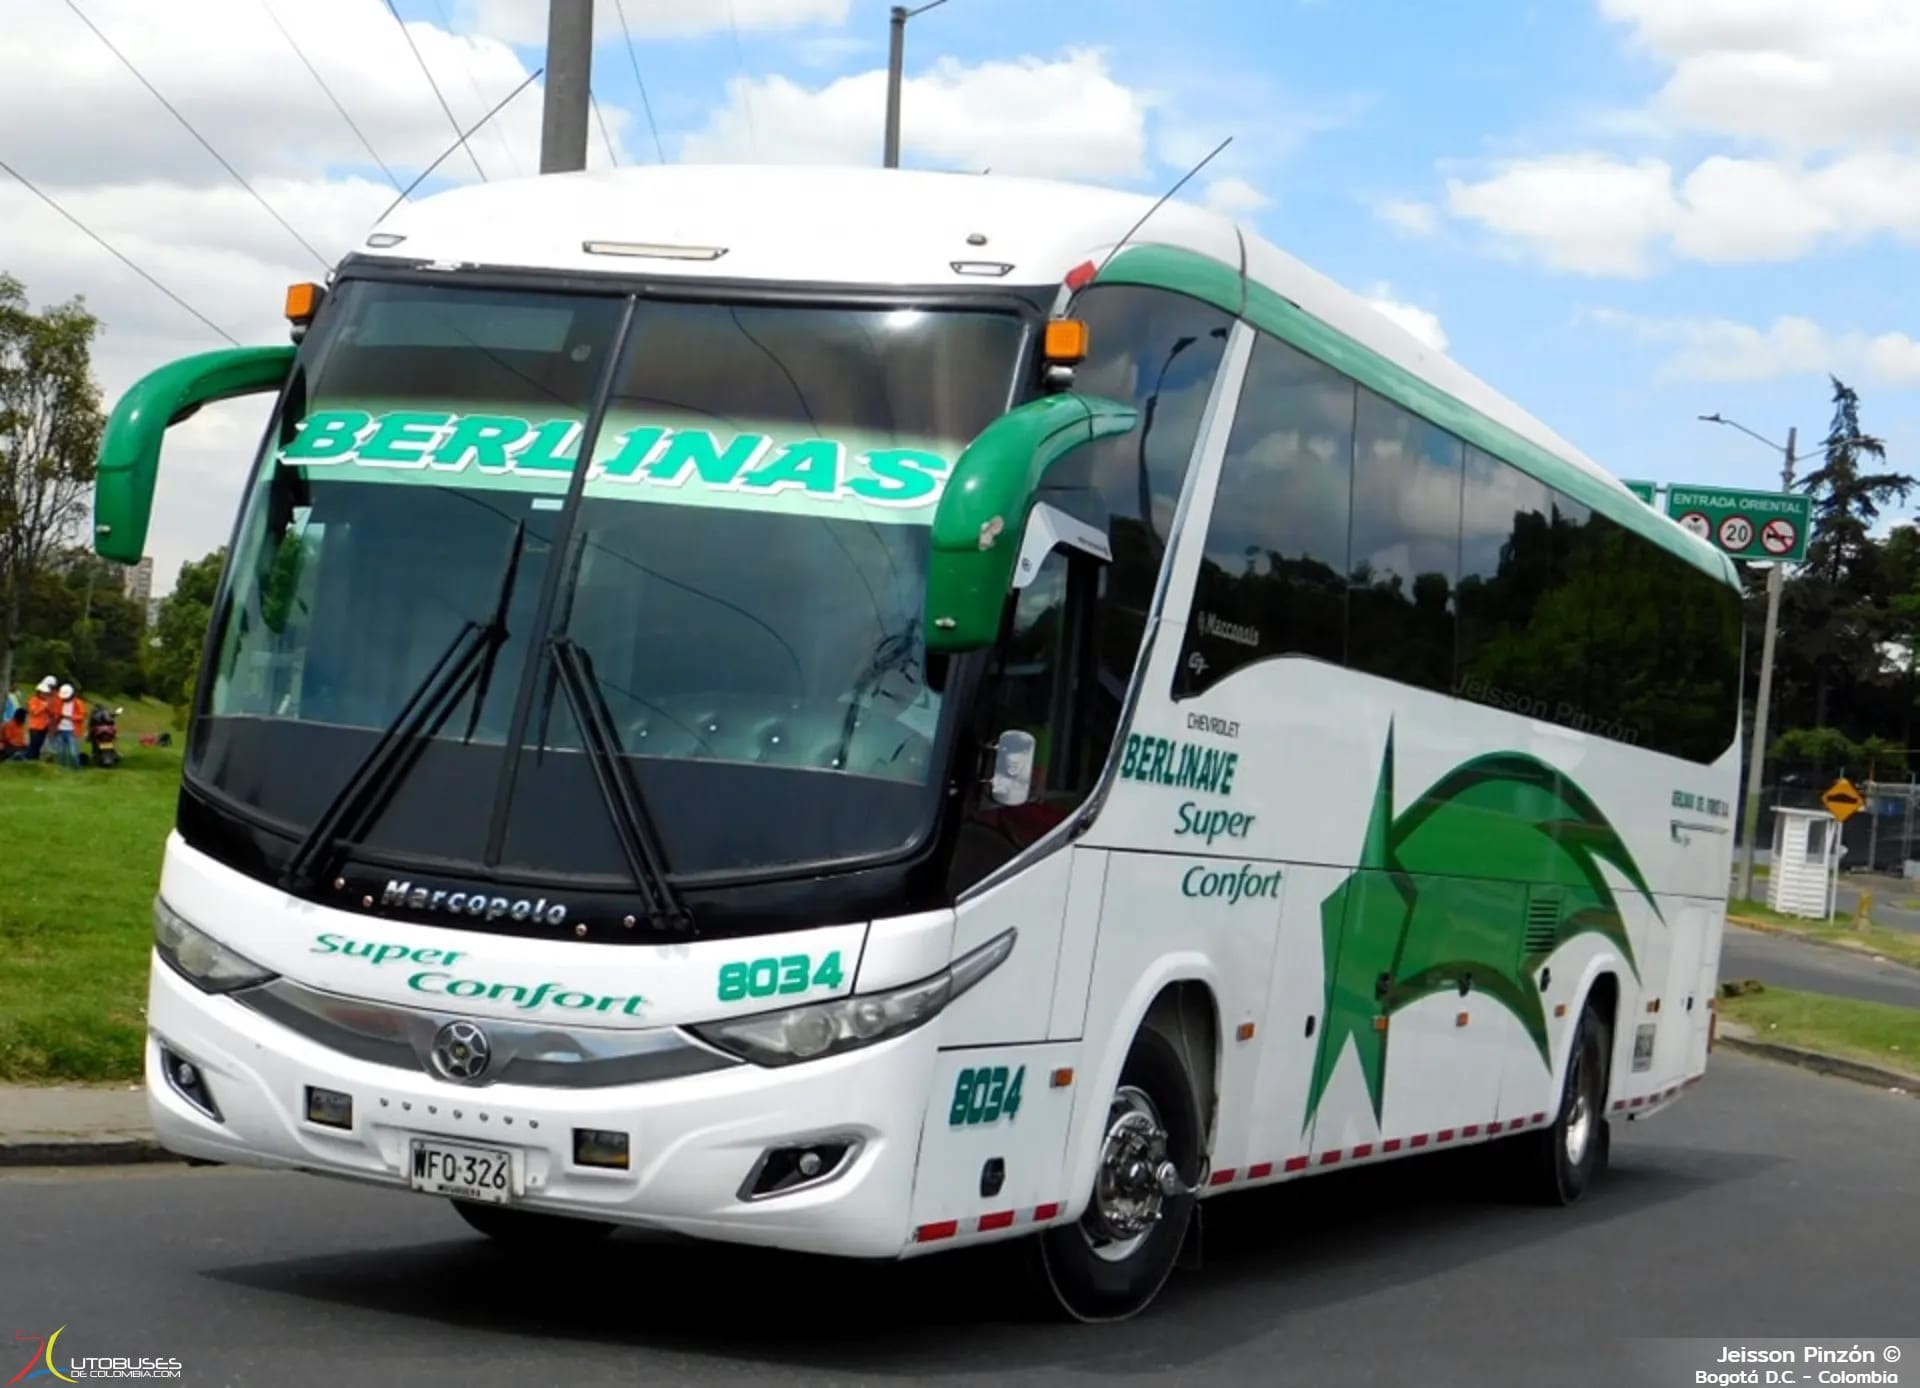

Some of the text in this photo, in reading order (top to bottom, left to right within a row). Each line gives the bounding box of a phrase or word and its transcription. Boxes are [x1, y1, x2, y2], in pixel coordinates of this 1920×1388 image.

[279, 410, 950, 508] BERLINAS
[1673, 493, 1804, 514] ENTRADA ORIENTAL
[1726, 524, 1749, 543] 20
[1187, 712, 1241, 738] CHEVROLET
[1120, 733, 1239, 796] BERLINAVE
[1173, 801, 1256, 846] Super
[381, 880, 568, 925] Marcopolo
[1181, 863, 1283, 906] Confort
[310, 933, 467, 966] Super
[407, 971, 649, 1017] Confort
[717, 950, 844, 1002] 8034
[948, 1064, 1027, 1127] 8034
